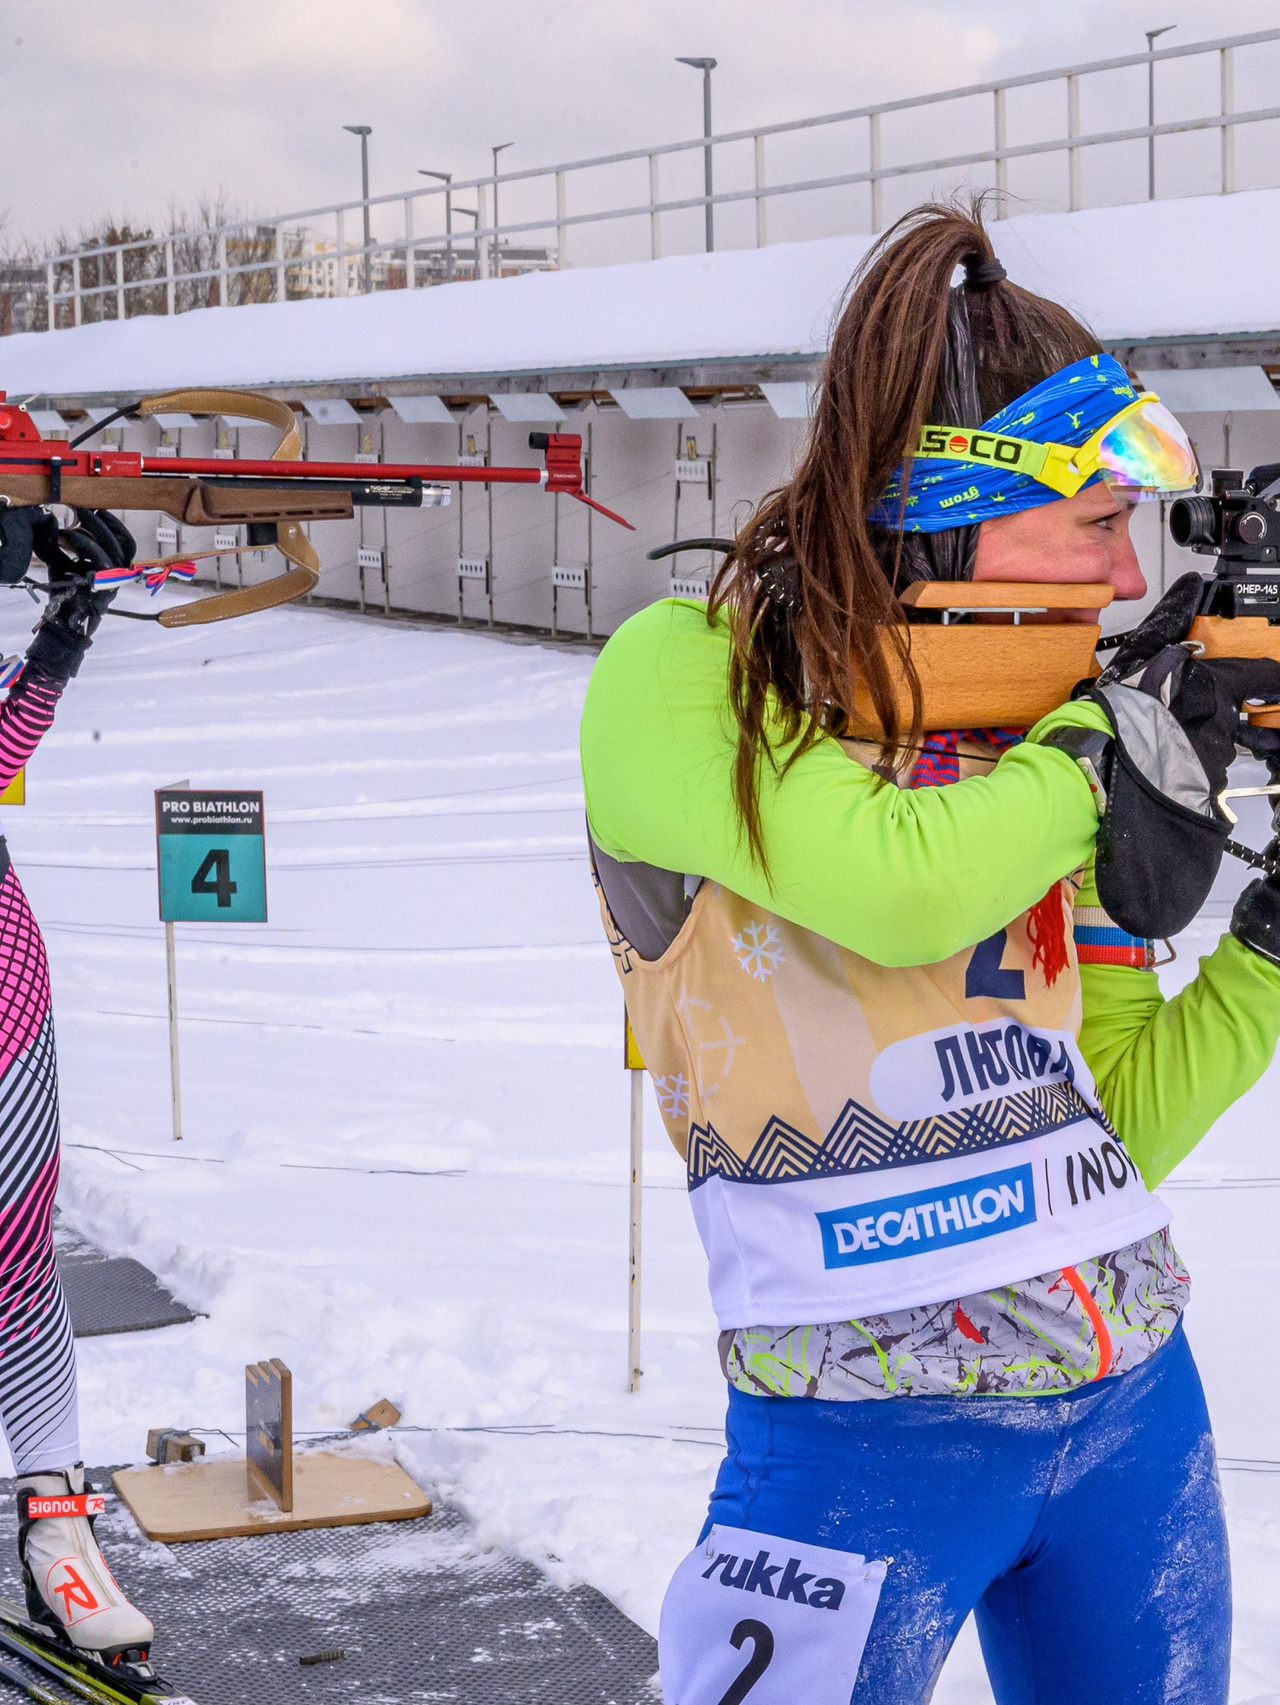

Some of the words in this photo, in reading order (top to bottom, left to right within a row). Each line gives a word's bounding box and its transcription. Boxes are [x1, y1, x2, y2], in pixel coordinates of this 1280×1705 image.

[939, 485, 981, 509] grom
[162, 801, 190, 813] PRO
[193, 801, 260, 813] BIATHLON
[171, 815, 252, 825] www.probiathlon.ru
[191, 849, 237, 908] 4
[832, 1180, 1025, 1254] DECATHLON
[701, 1550, 846, 1611] rukka
[717, 1618, 775, 1705] 2
